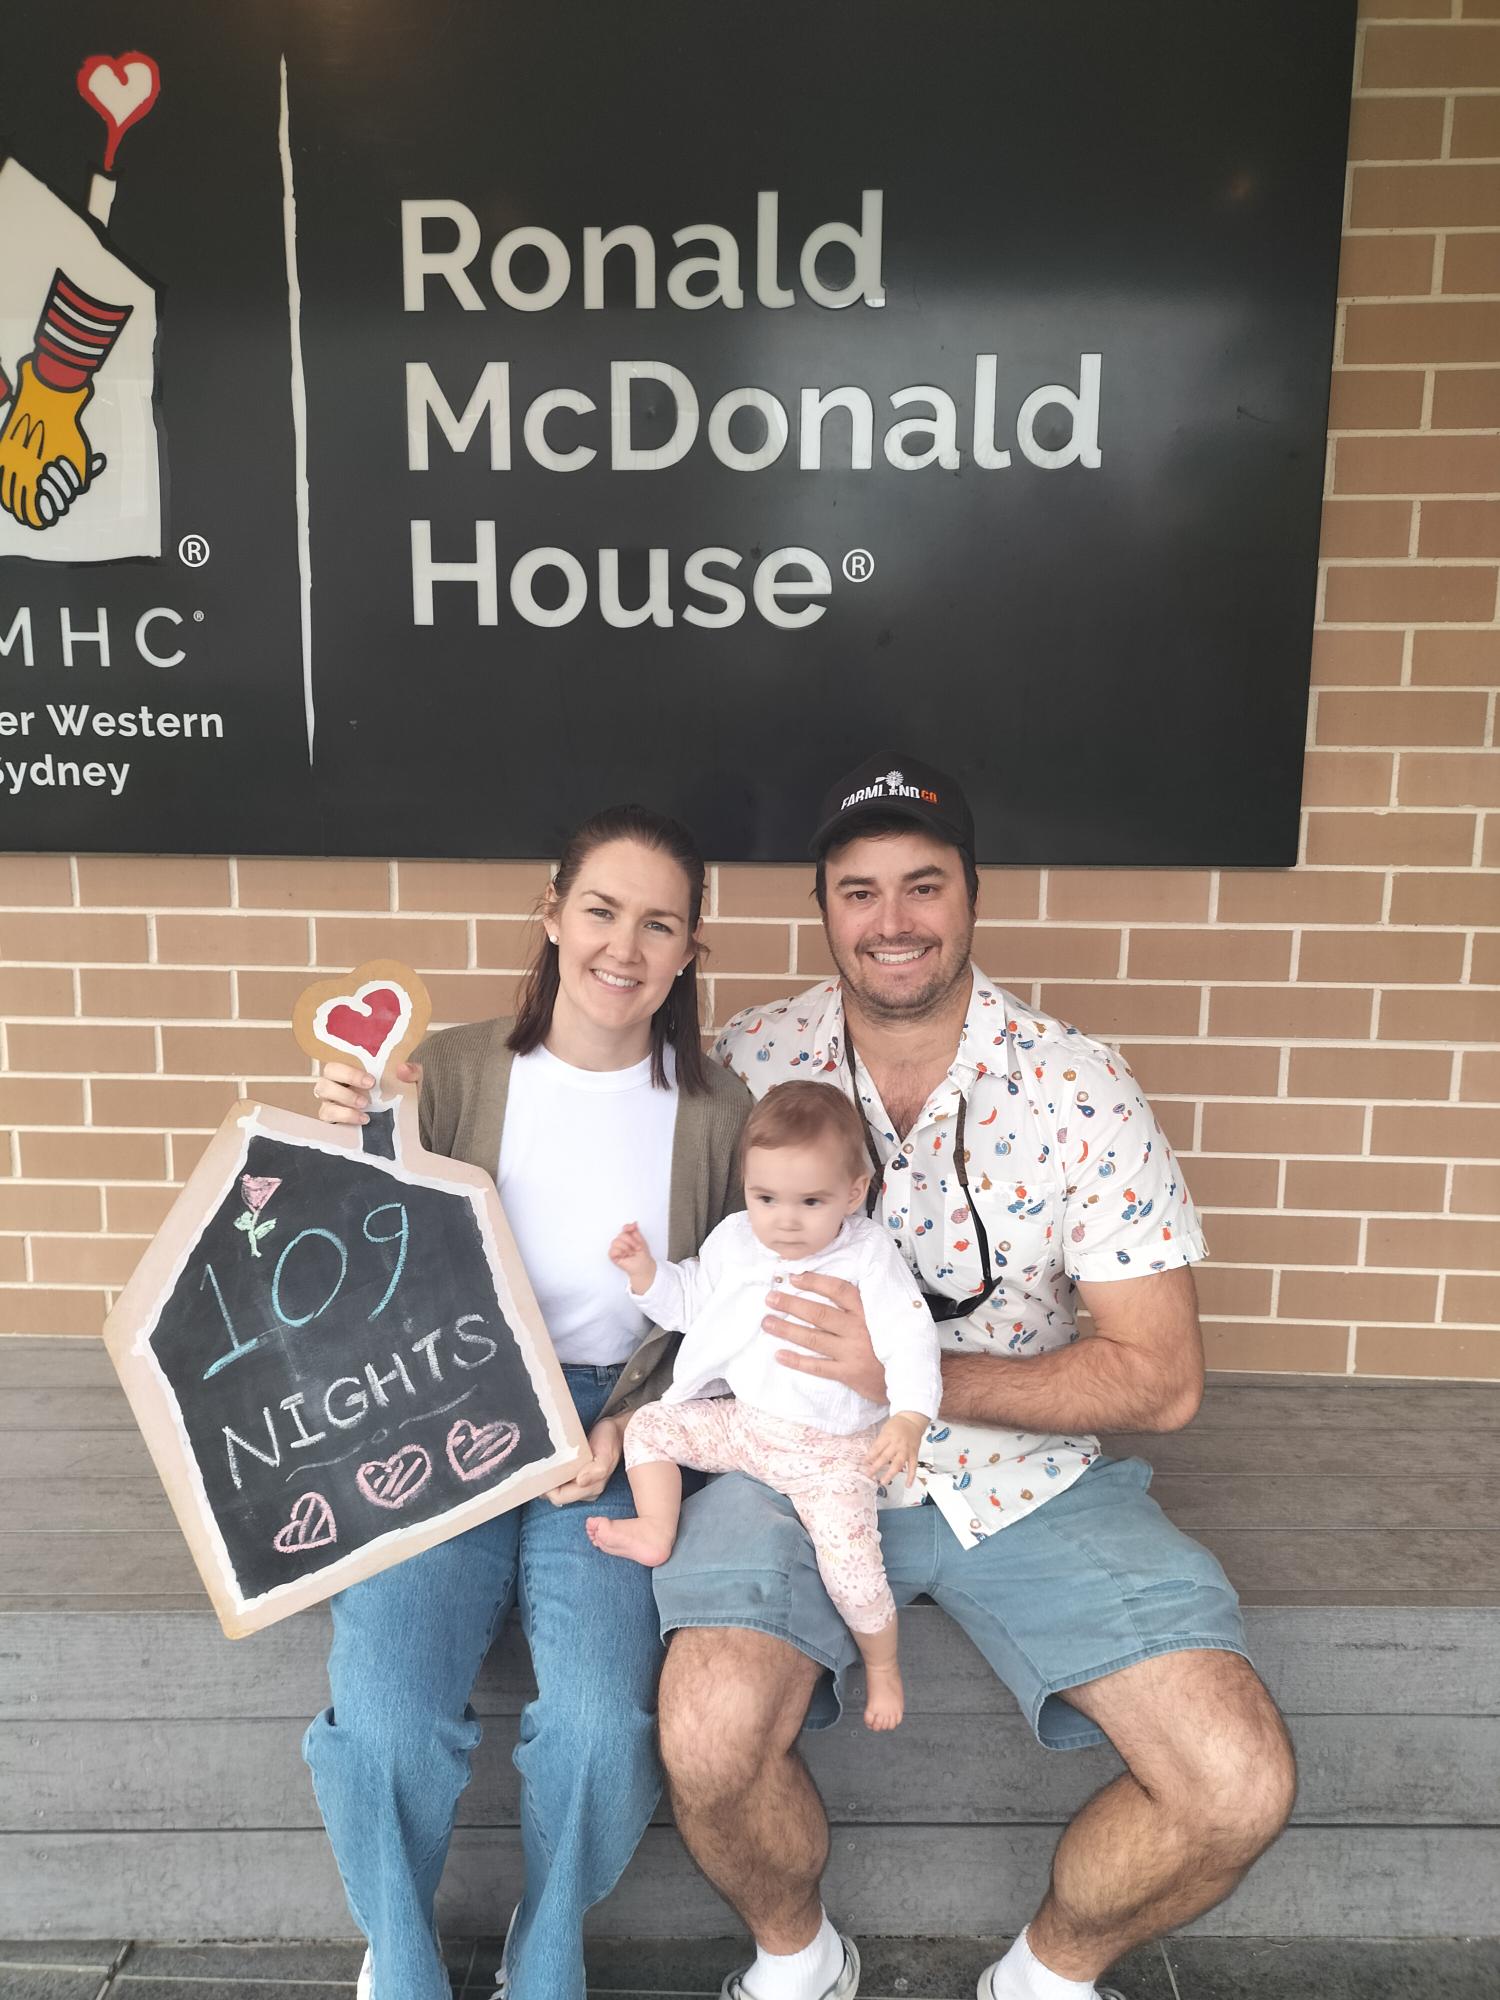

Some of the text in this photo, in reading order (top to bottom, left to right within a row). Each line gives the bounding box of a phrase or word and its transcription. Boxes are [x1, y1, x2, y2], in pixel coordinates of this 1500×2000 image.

[402, 190, 886, 312] Ronald
[406, 353, 1103, 472] McDonald
[0, 753, 130, 796] ydney
[46, 704, 224, 738] Western
[200, 1202, 409, 1380] 109
[222, 1313, 498, 1489] NIGHTS
